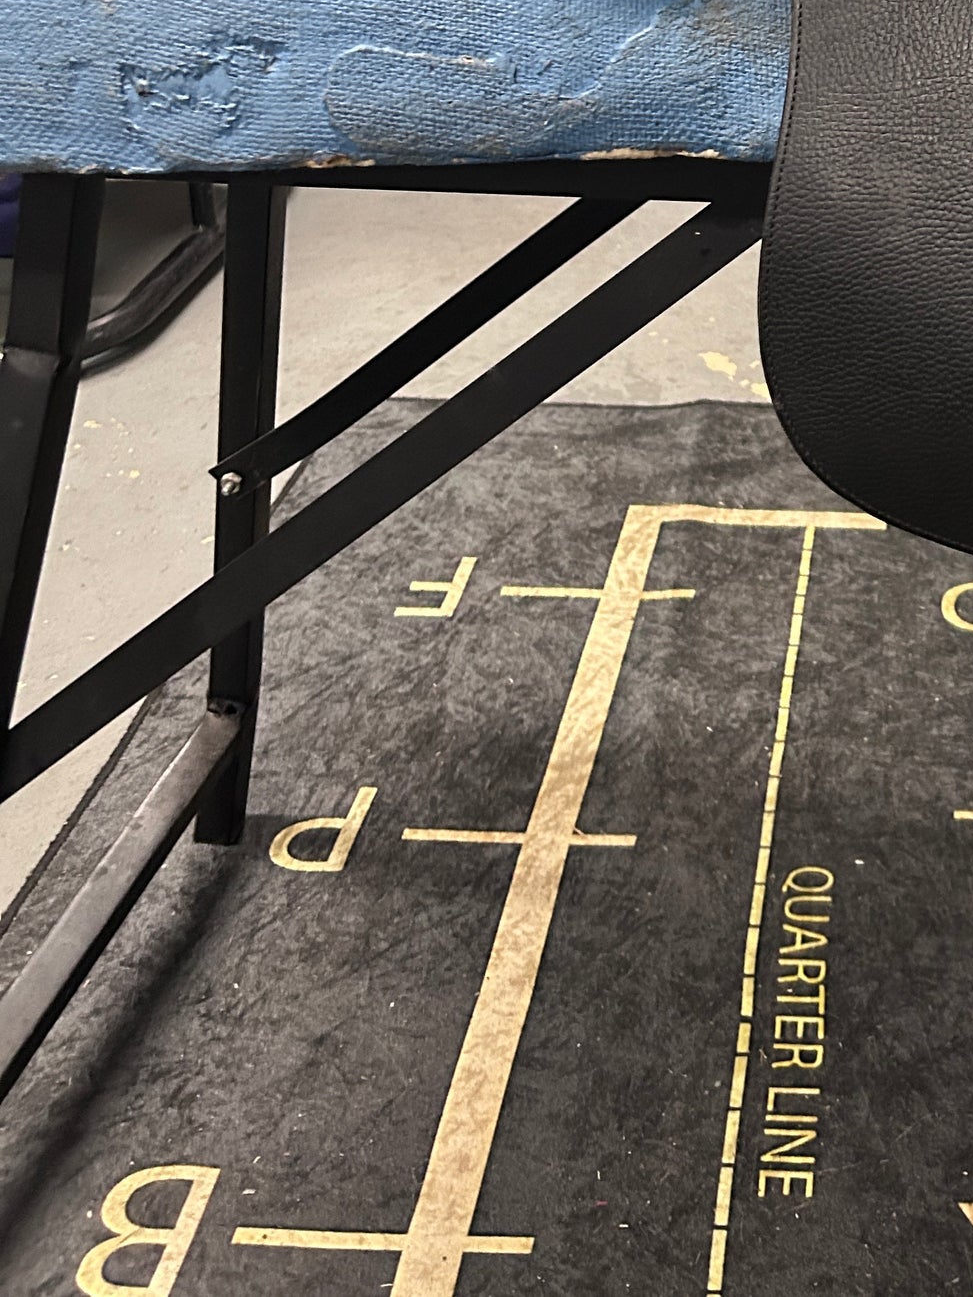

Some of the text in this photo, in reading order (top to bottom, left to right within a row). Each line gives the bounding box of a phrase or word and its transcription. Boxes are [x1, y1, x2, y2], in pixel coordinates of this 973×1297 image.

[395, 555, 478, 617] F
[269, 786, 378, 873] P
[758, 865, 834, 1198] QUARTER LINE
[75, 1164, 221, 1297] B
